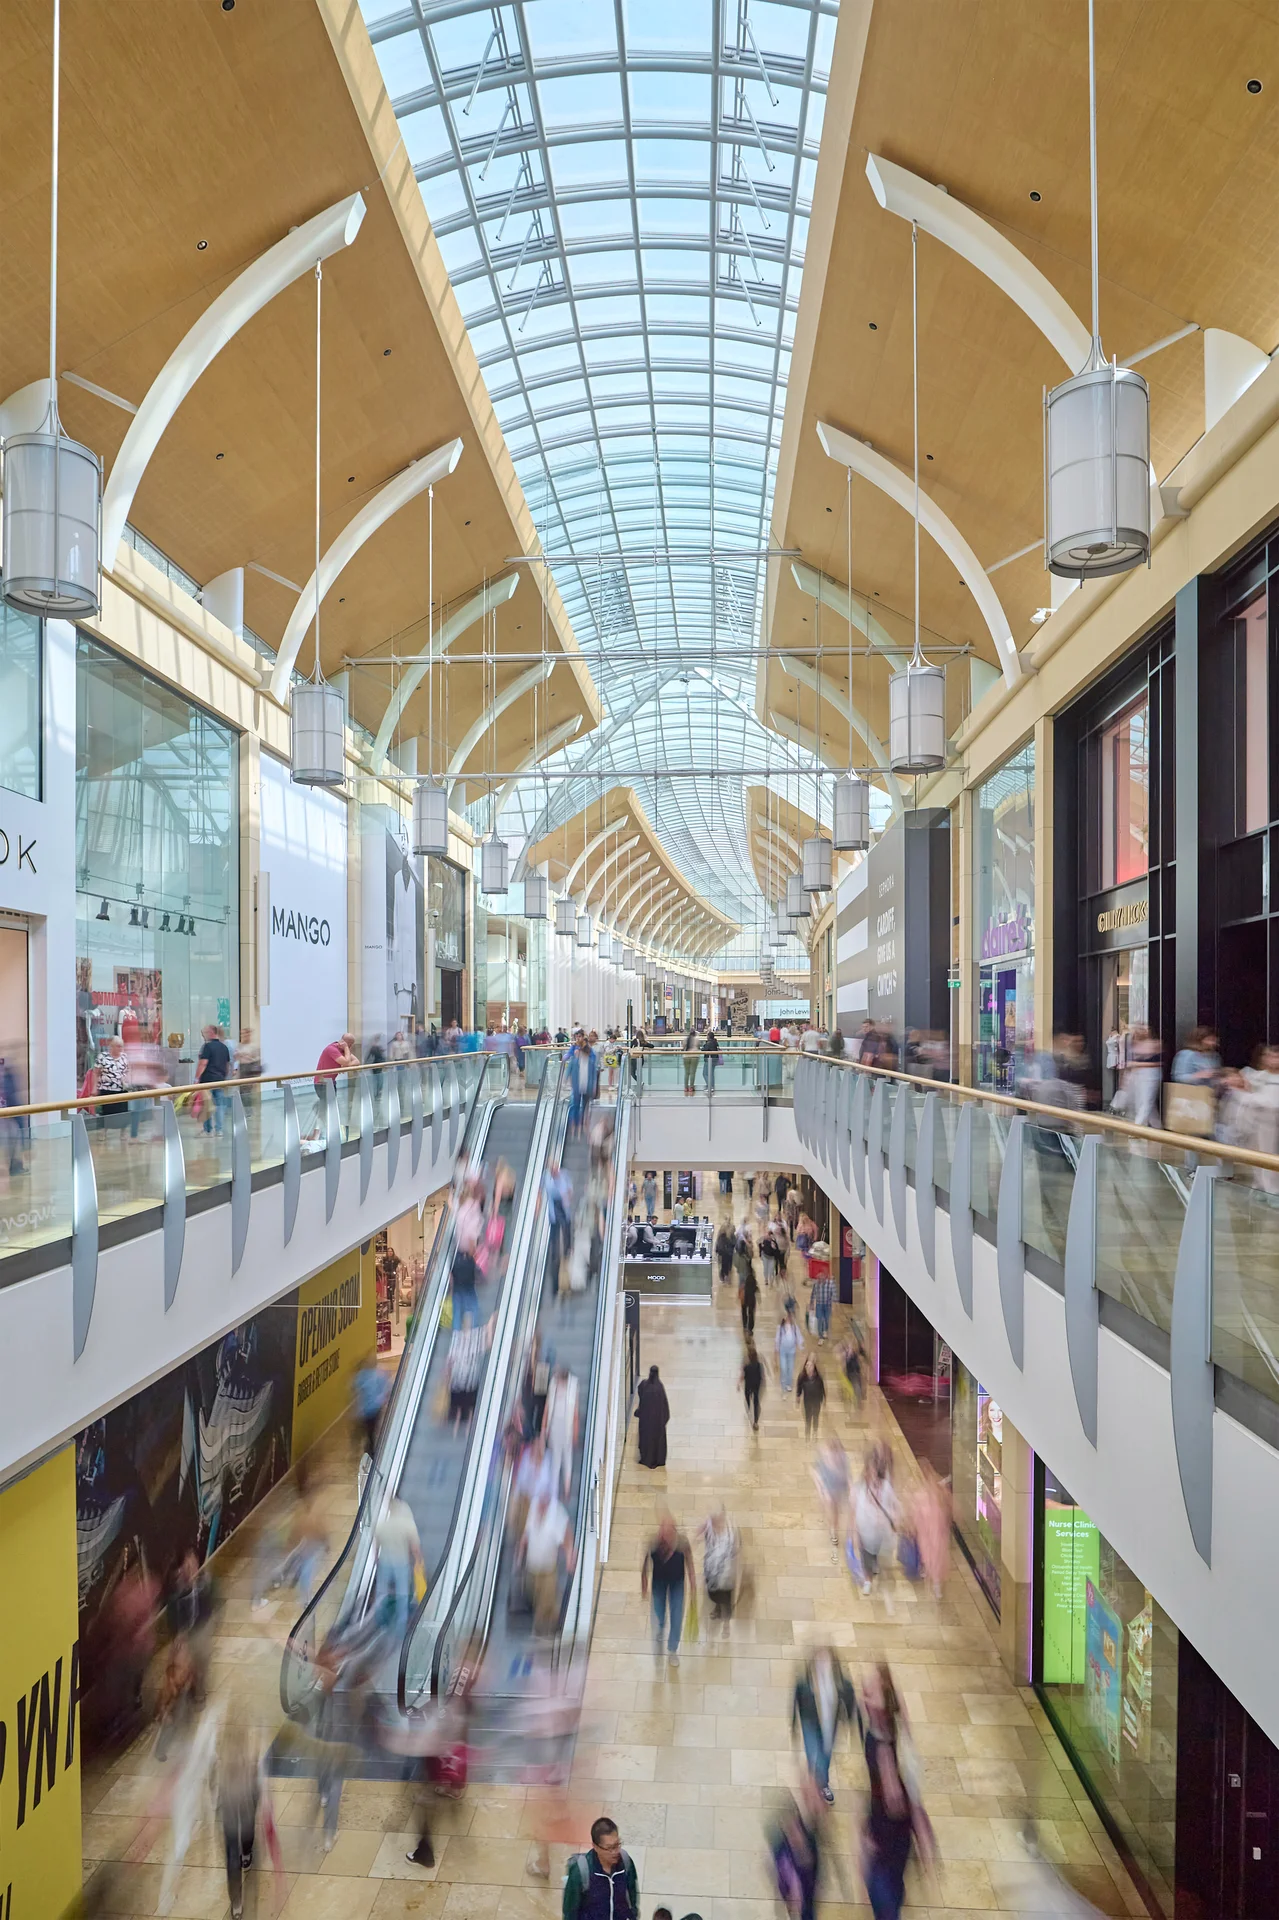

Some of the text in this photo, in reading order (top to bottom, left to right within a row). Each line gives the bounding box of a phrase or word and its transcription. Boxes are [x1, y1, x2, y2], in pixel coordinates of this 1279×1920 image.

[272, 905, 331, 946] MANGO
[982, 903, 1028, 959] claire's
[779, 1008, 795, 1016] John
[299, 1271, 360, 1368] OPENING SOON
[1048, 1520, 1072, 1528] Nurse
[1055, 1529, 1089, 1538] Services
